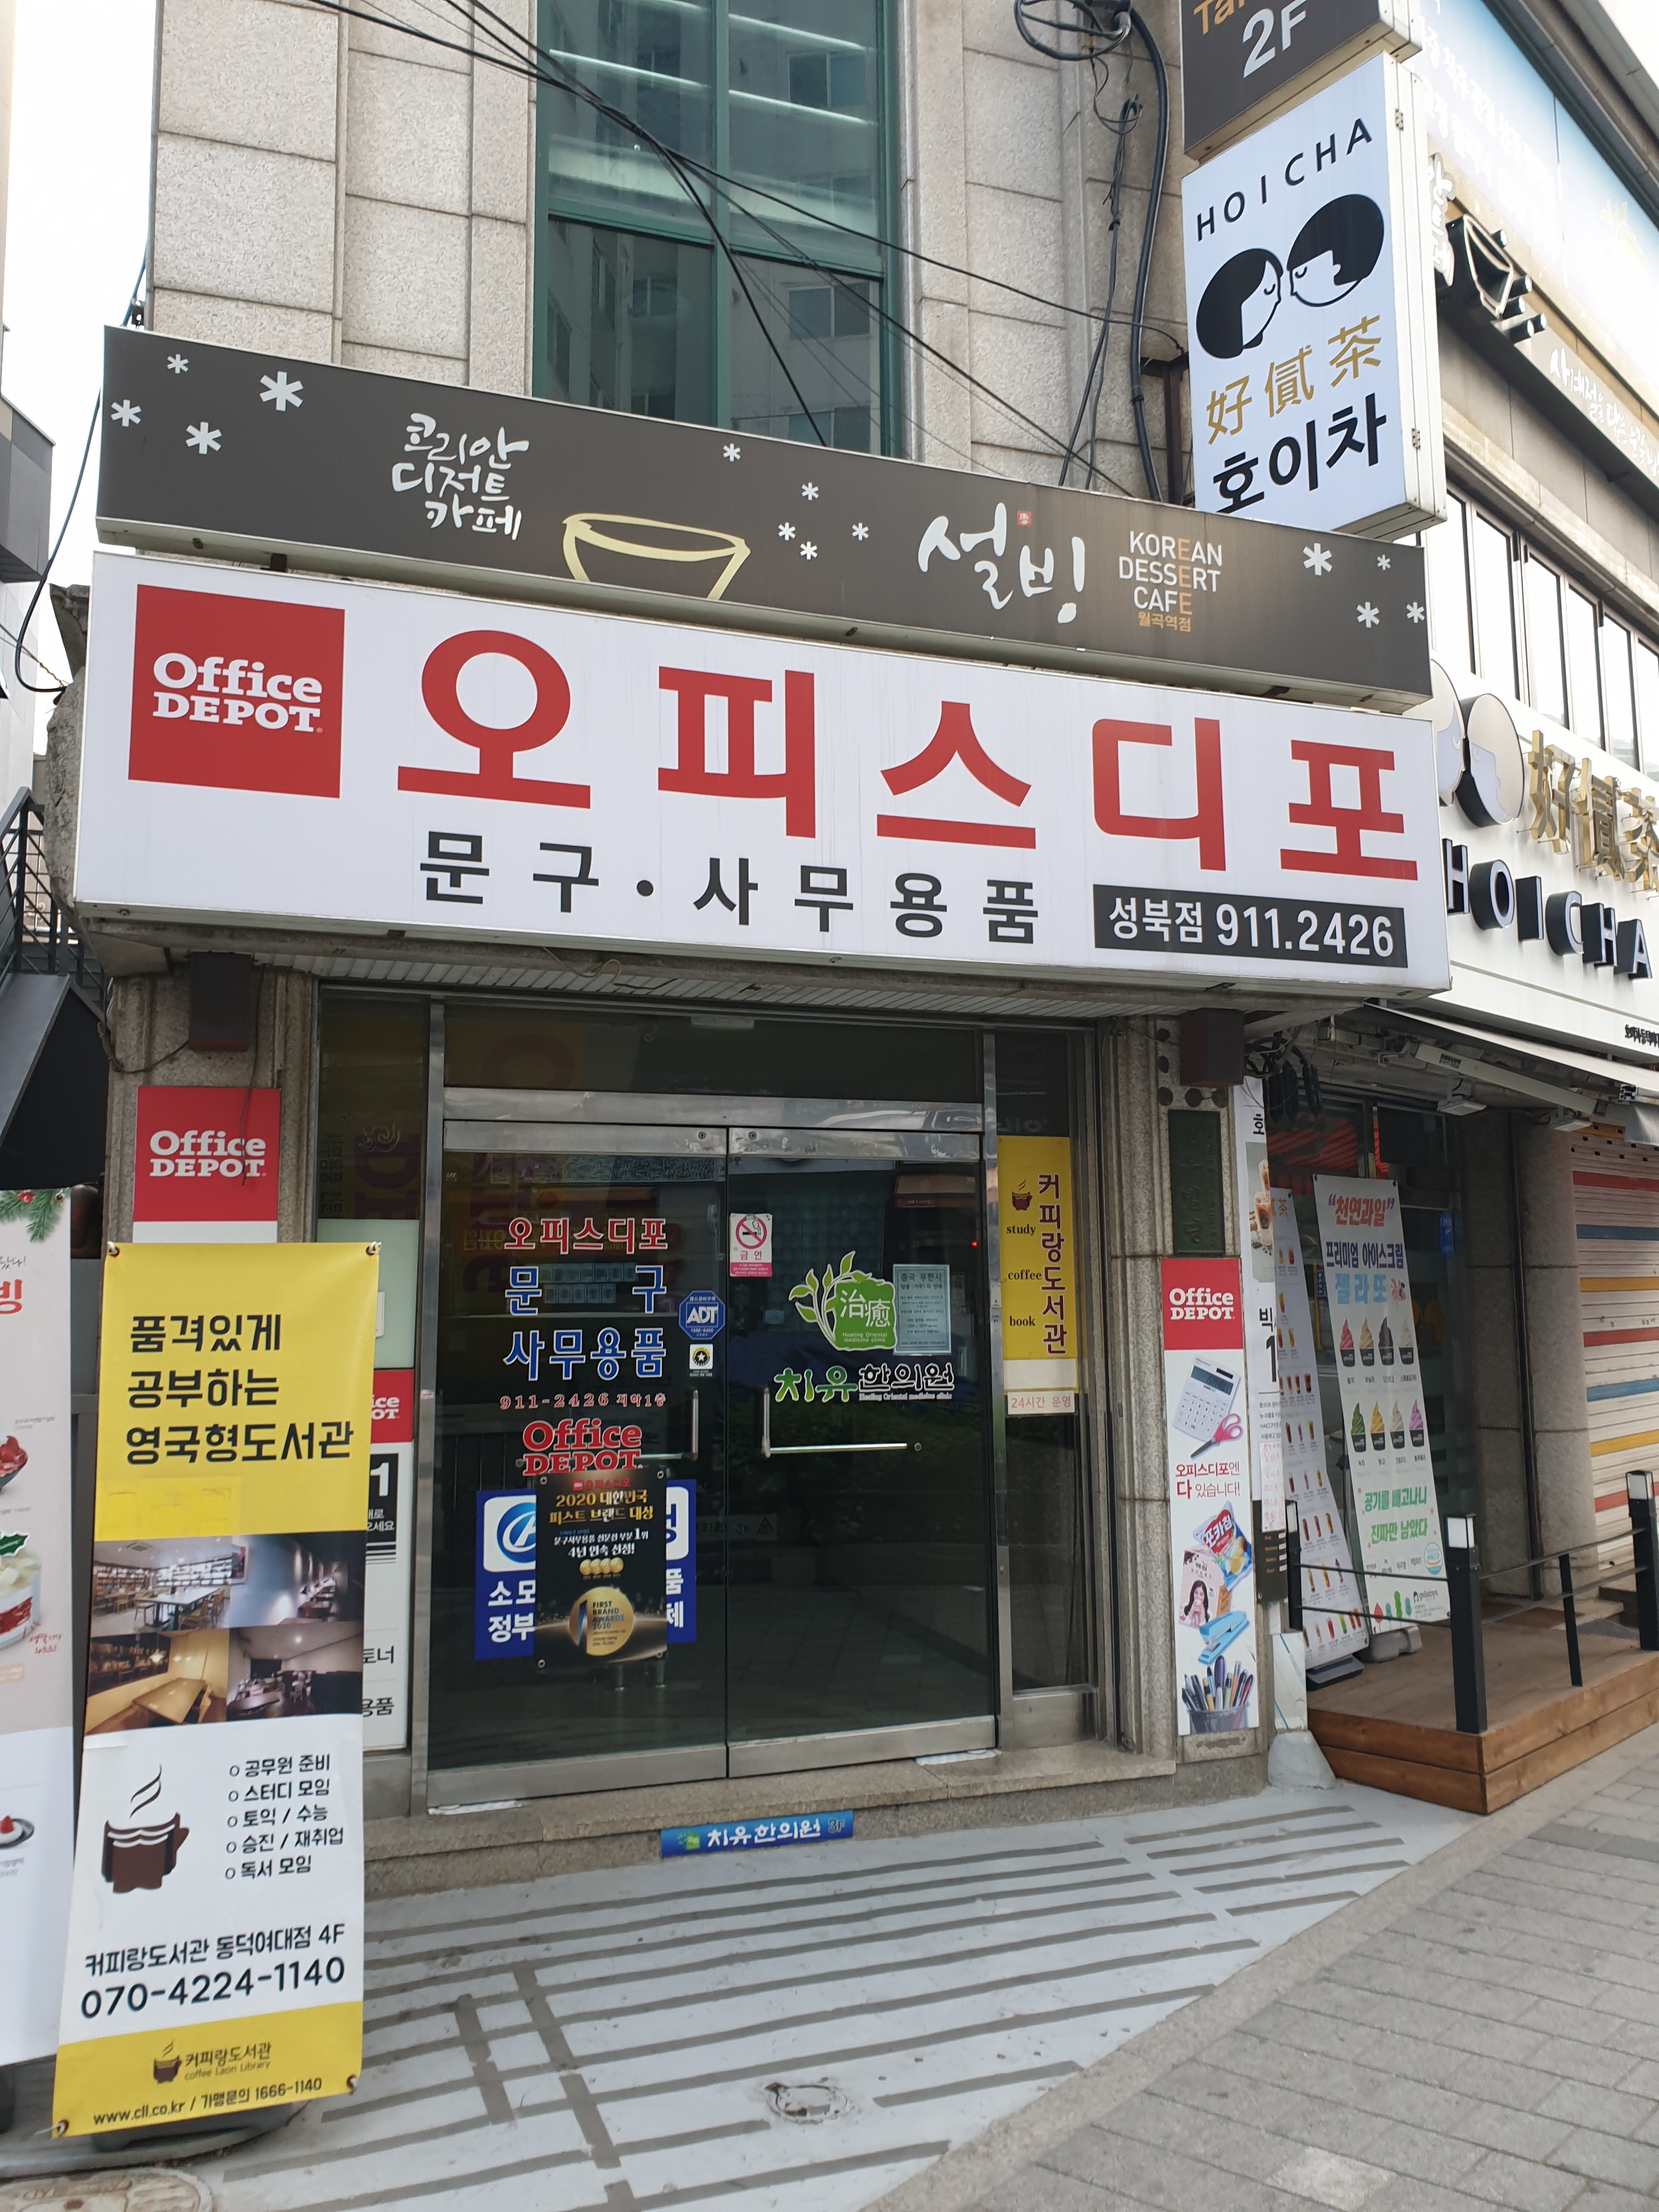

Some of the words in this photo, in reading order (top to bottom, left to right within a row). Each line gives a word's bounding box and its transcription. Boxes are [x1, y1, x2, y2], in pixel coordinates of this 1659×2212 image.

[1193, 0, 1245, 36] Ta
[1242, 0, 1307, 79] 2F
[1197, 117, 1373, 242] HOICHA
[404, 412, 530, 470] 코리안
[1213, 393, 1387, 514] 호이차
[392, 460, 511, 503] 디저트
[424, 493, 523, 541] 카페
[918, 502, 1086, 624] 설빙
[1129, 529, 1223, 567] KOREAN
[1118, 555, 1222, 594] DESSERT
[1132, 586, 1194, 617] CAFE
[1136, 611, 1192, 633] 월곡역점
[152, 652, 324, 705] Office
[151, 690, 324, 734] DEPOT
[397, 629, 1420, 882] 오피스디포
[1442, 838, 1653, 980] HOICHA
[1108, 896, 1205, 944] 성북점
[1215, 901, 1395, 959] 911.2426
[149, 1129, 267, 1157] Office
[149, 1158, 267, 1178] DEPOT
[504, 1216, 668, 1255] 오피스디포
[1006, 1223, 1037, 1236] study
[1037, 1173, 1068, 1356] 커피랑도서관
[1326, 1241, 1359, 1268] 프리미엄
[1362, 1243, 1404, 1269] 아이스크림
[1007, 1268, 1042, 1281] coffee
[1169, 1287, 1234, 1306] Office
[686, 1306, 719, 1324] ADT
[1009, 1314, 1036, 1327] book
[1170, 1306, 1234, 1321] DEPOT
[130, 1314, 282, 1353] 품격있게
[503, 1326, 667, 1381] 사무용품
[127, 1368, 280, 1409] 공부하는
[499, 1392, 610, 1411] 911-2426
[616, 1392, 667, 1408] 지하1층
[1011, 1395, 1046, 1409] 24시간
[1051, 1395, 1071, 1408] 운영
[126, 1421, 354, 1465] 영국형도서관
[522, 1418, 642, 1452] Office
[522, 1448, 642, 1477] DEPOT
[1175, 1460, 1240, 1478] 오피스디포엔
[555, 1493, 596, 1508] 2020
[1176, 1480, 1192, 1500] 다
[1194, 1481, 1240, 1498] 있습니다!
[244, 1755, 294, 1777] 공무원
[298, 1753, 331, 1773] 준비
[243, 1780, 293, 1803] 스터디
[297, 1778, 331, 1798] 모임
[242, 1807, 276, 1829] 토익
[296, 1803, 329, 1825] 수능
[241, 1832, 275, 1855] 승진
[294, 1826, 345, 1849] 재취업
[707, 1818, 821, 1848] 치유한의원
[828, 1819, 845, 1834] 3F
[239, 1858, 274, 1879] 독서
[277, 1854, 313, 1876] 모임
[84, 1936, 210, 1978] 커피랑도서관
[216, 1925, 312, 1962] 동덕여대점
[318, 1922, 346, 1945] 4F
[80, 1955, 347, 2020] 070-4224-1140
[184, 2040, 272, 2068] 커피랑도서관
[255, 2076, 323, 2103] 1666-1140
